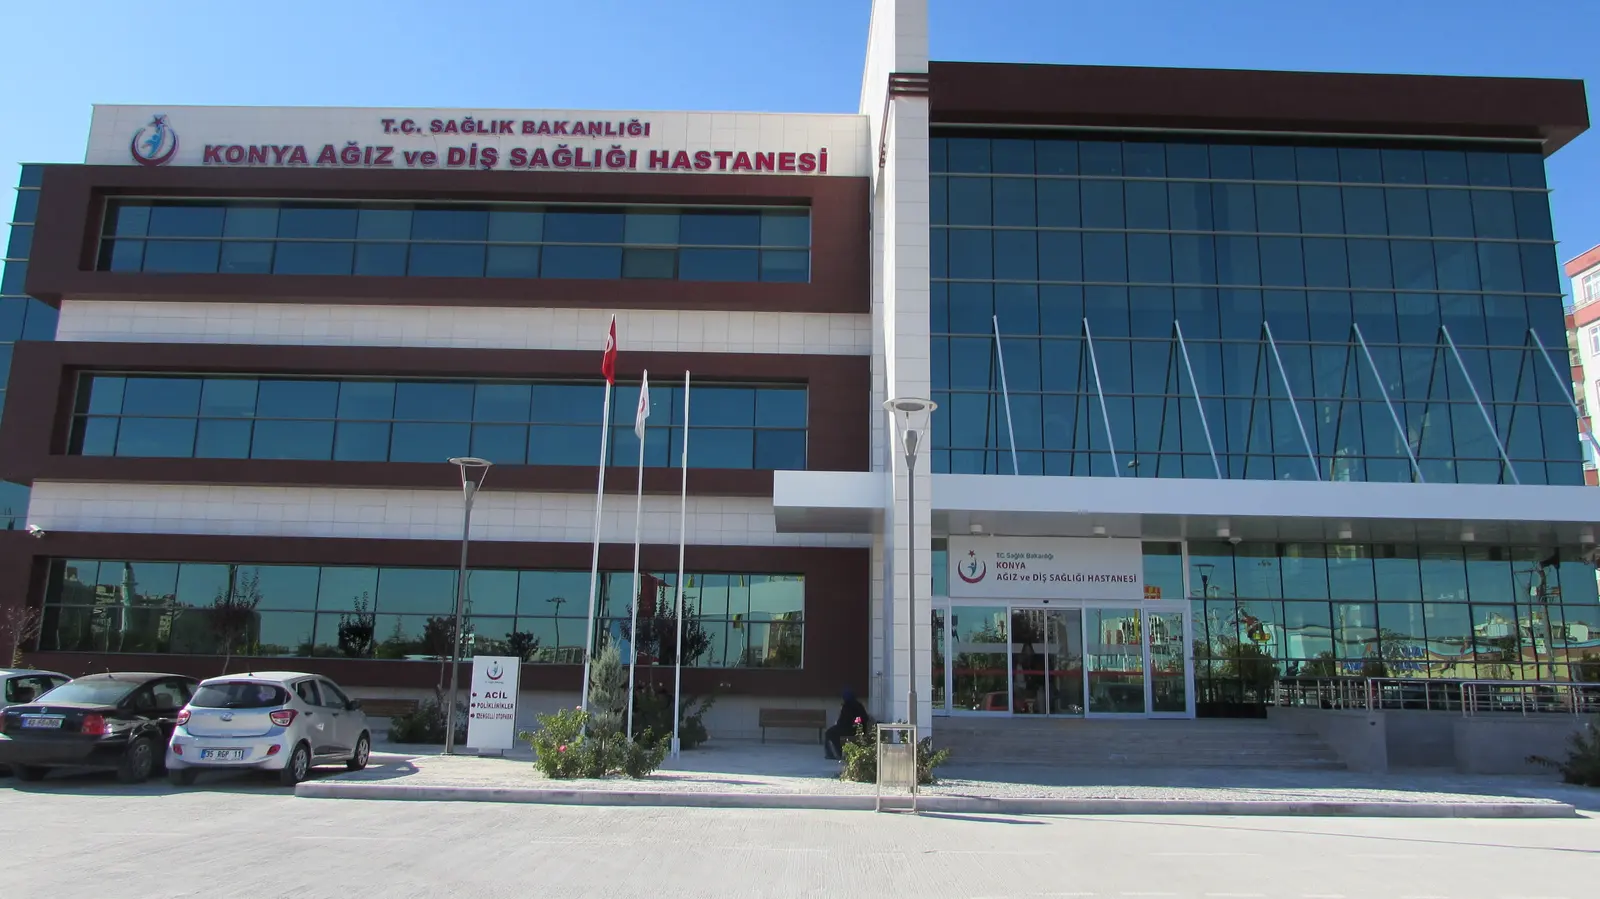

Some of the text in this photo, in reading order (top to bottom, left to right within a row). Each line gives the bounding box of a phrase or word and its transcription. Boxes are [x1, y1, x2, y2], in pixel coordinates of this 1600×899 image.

[381, 115, 651, 138] T.C. SAĞLIK BAKANLIĞI
[203, 141, 829, 175] KONYA AĞIZ ve DİŞ SAĞLIĞI HASTANESİ
[1007, 552, 1025, 560] Sağlık
[996, 561, 1026, 569] KONYA
[996, 571, 1018, 581] AĞIZ
[1032, 571, 1047, 583] DİŞ
[1049, 572, 1085, 582] SAĞLIĞI
[1087, 573, 1137, 583] HASTANESİ
[484, 690, 508, 699] ACİL
